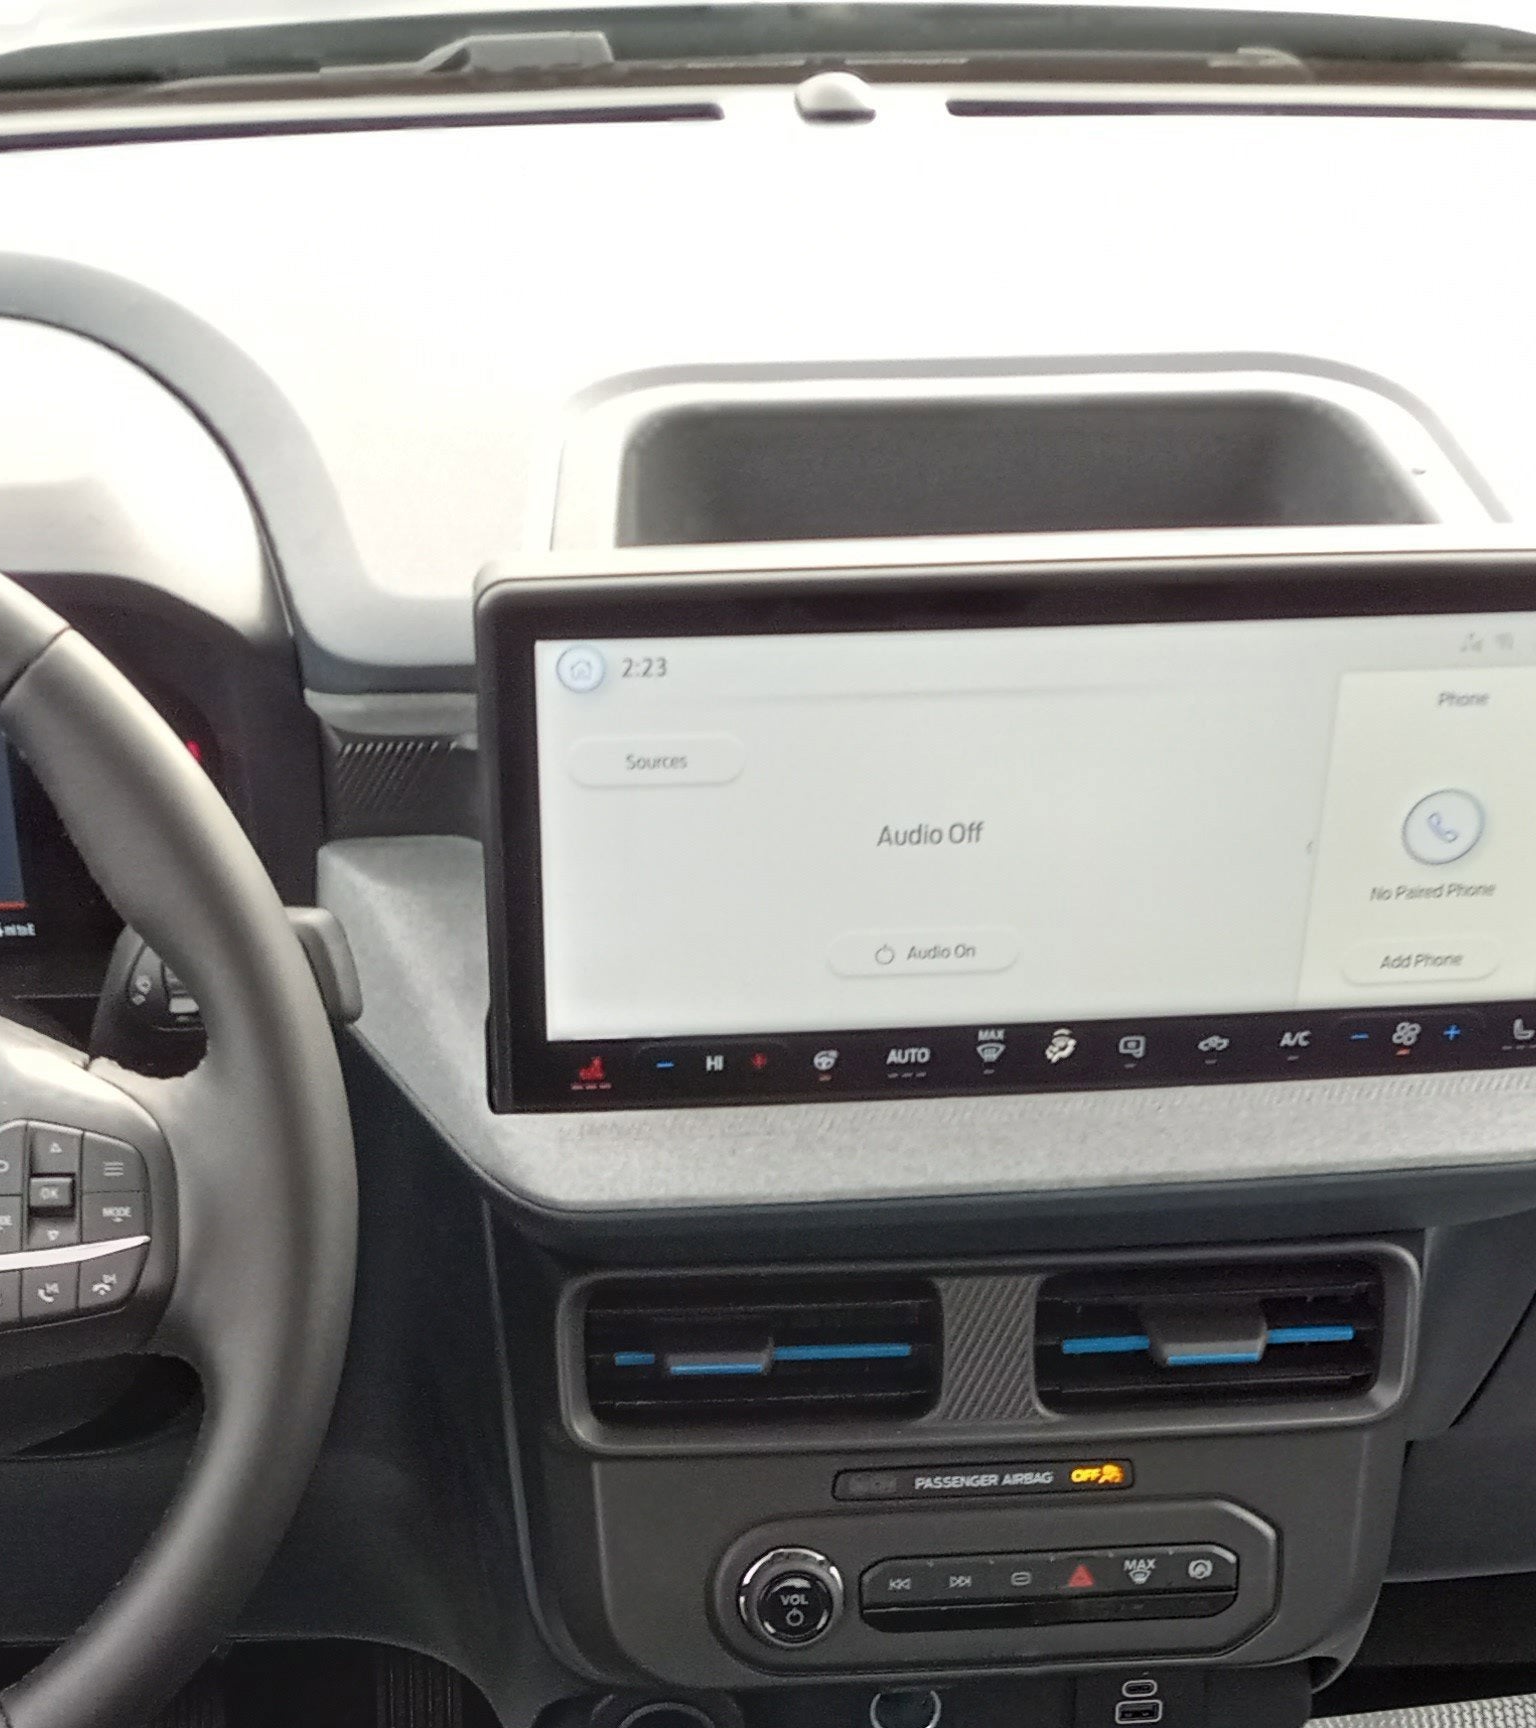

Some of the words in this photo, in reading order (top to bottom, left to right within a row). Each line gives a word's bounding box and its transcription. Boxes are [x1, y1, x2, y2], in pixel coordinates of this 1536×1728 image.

[622, 657, 668, 678] 2:23
[1438, 692, 1489, 706] Phone
[625, 752, 688, 770] Sources
[877, 824, 943, 847] Audio
[949, 821, 984, 844] Off
[1370, 886, 1392, 901] No
[1395, 885, 1444, 900] Paired
[1446, 883, 1496, 898] Phone
[907, 945, 951, 961] Audio
[954, 943, 977, 959] On
[1380, 954, 1411, 969] Add
[1414, 953, 1463, 967] Phone
[977, 1029, 1005, 1042] MAX
[1279, 1030, 1312, 1048] A/C
[706, 1055, 724, 1071] HI
[886, 1047, 931, 1065] AUTO
[40, 1186, 59, 1199] OK
[102, 1207, 132, 1219] MODE
[914, 1475, 998, 1490] PASSENGER
[1002, 1471, 1054, 1486] AIRBAG
[1070, 1467, 1100, 1483] OFF
[1123, 1559, 1156, 1571] MAX
[781, 1594, 809, 1605] VOL
